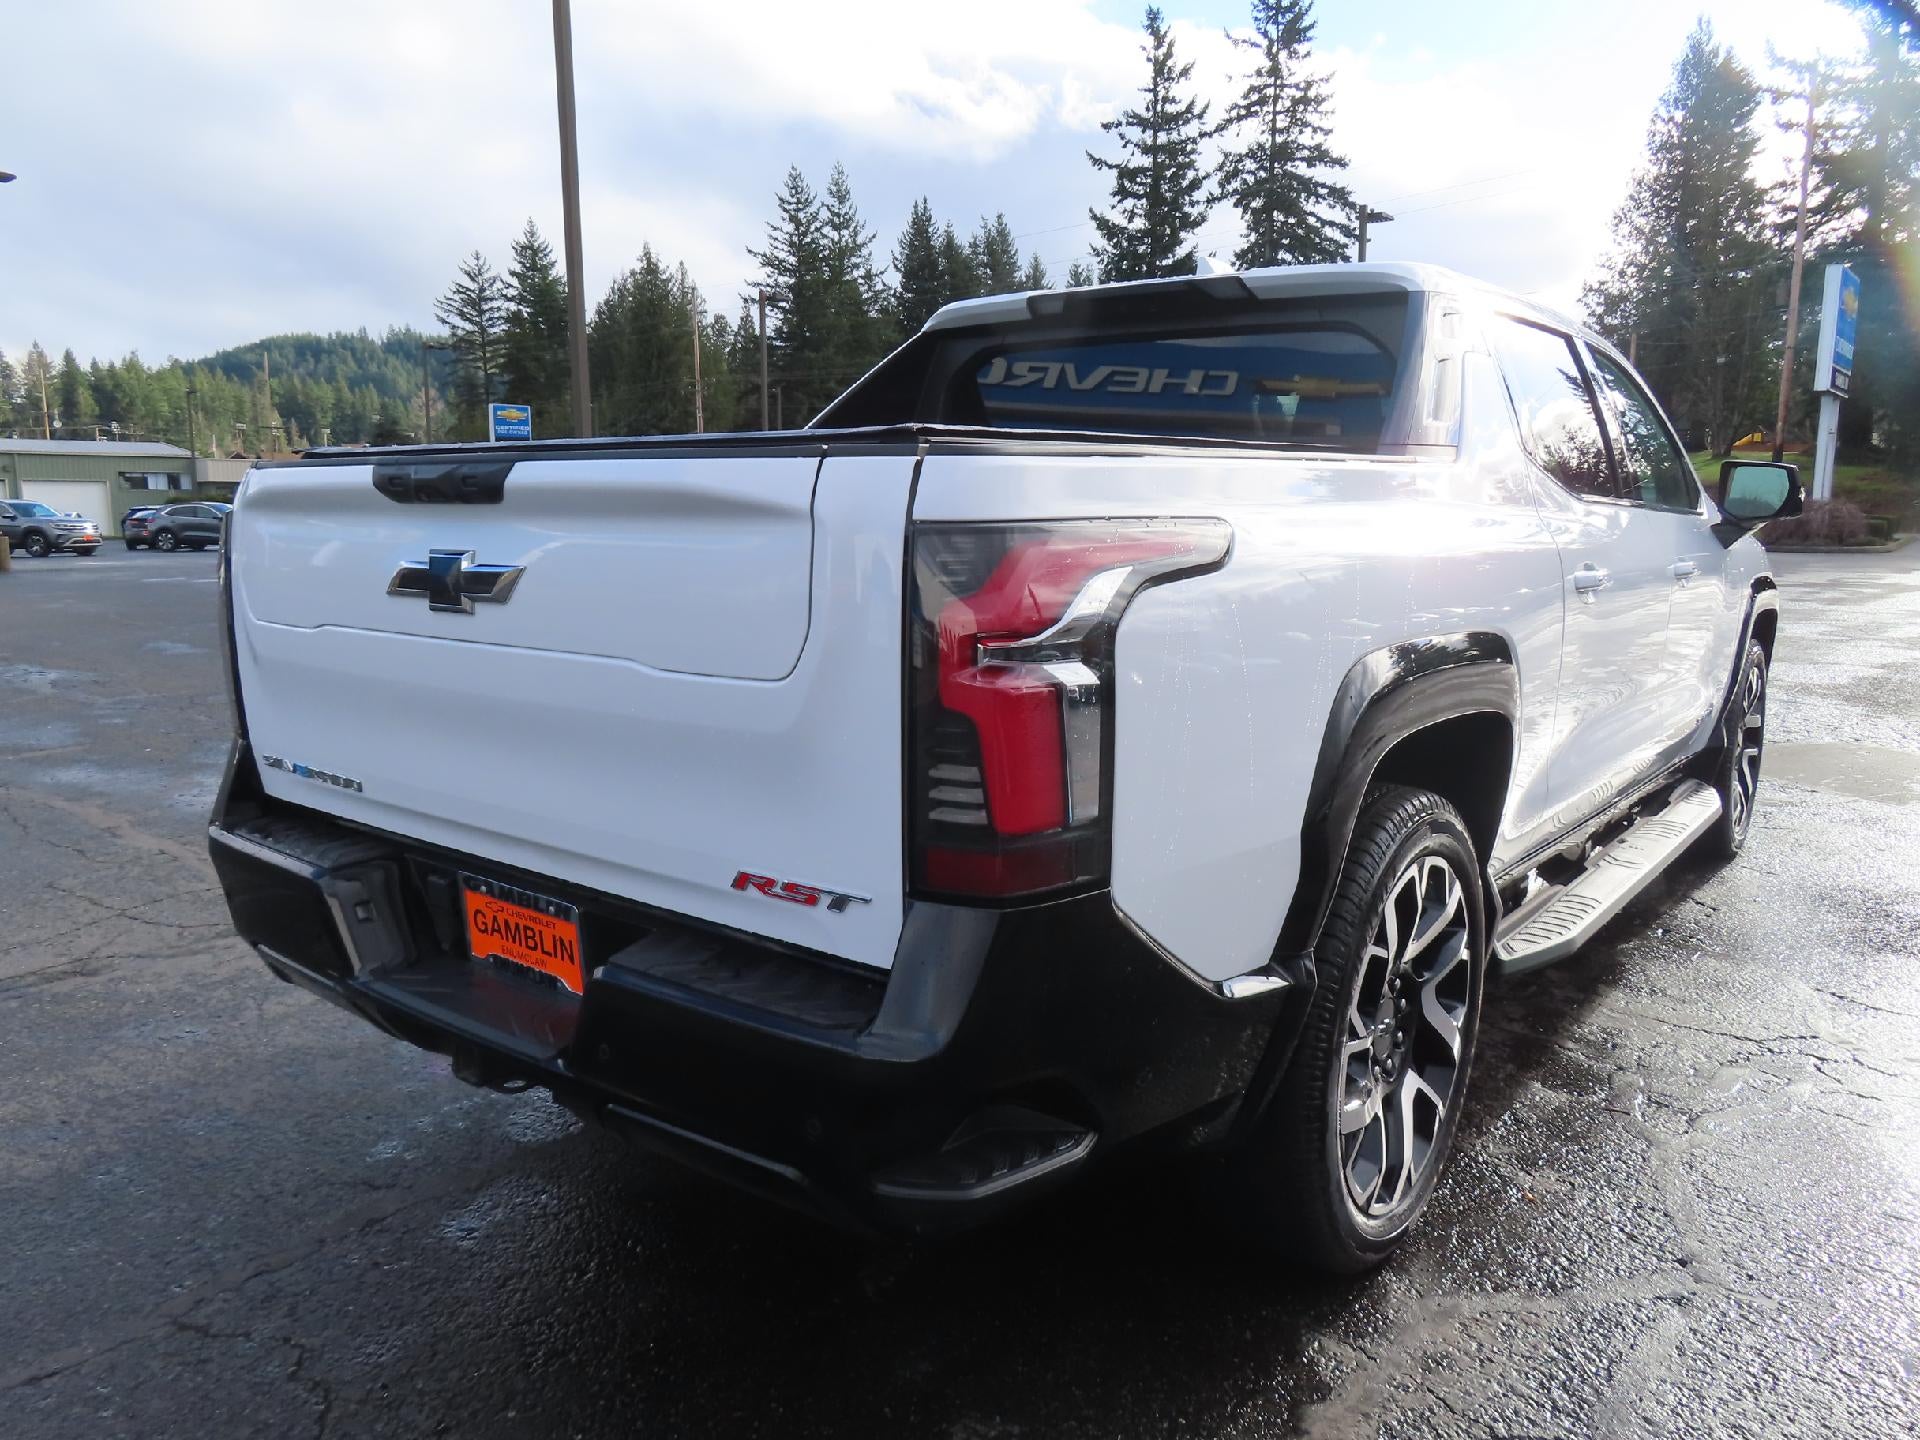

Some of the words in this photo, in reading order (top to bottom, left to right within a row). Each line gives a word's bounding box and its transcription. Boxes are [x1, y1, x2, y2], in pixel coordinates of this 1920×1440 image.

[730, 870, 873, 913] RST
[473, 908, 576, 966] GAMBLIN
[506, 907, 557, 931] CHEVROLET
